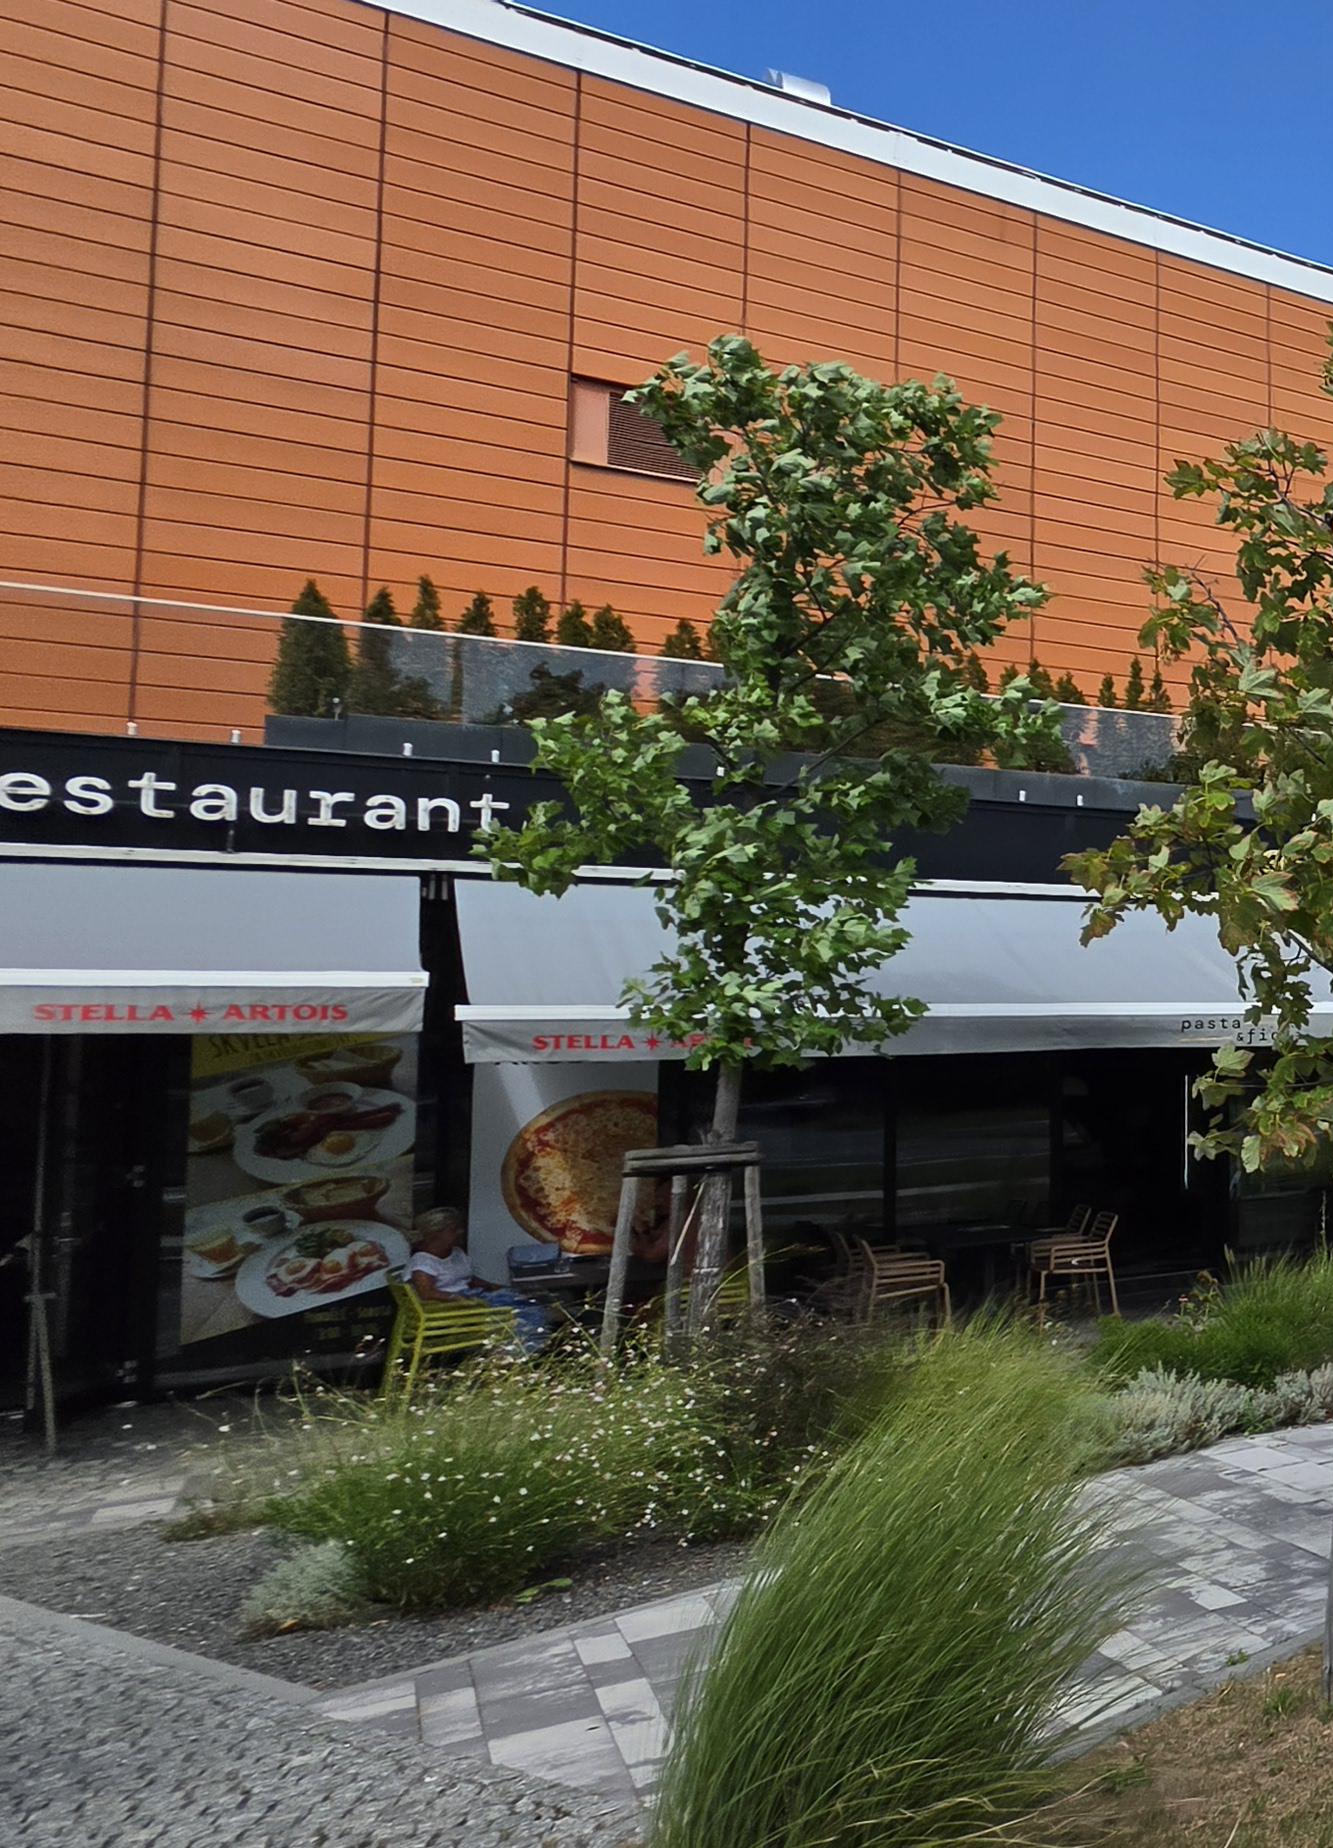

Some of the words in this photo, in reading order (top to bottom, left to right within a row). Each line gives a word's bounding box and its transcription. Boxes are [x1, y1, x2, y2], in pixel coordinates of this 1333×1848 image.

[34, 1004, 174, 1022] STELLA
[223, 1003, 349, 1022] ARTOIS
[1181, 1018, 1241, 1032] pasta
[532, 1034, 635, 1051] STELLA
